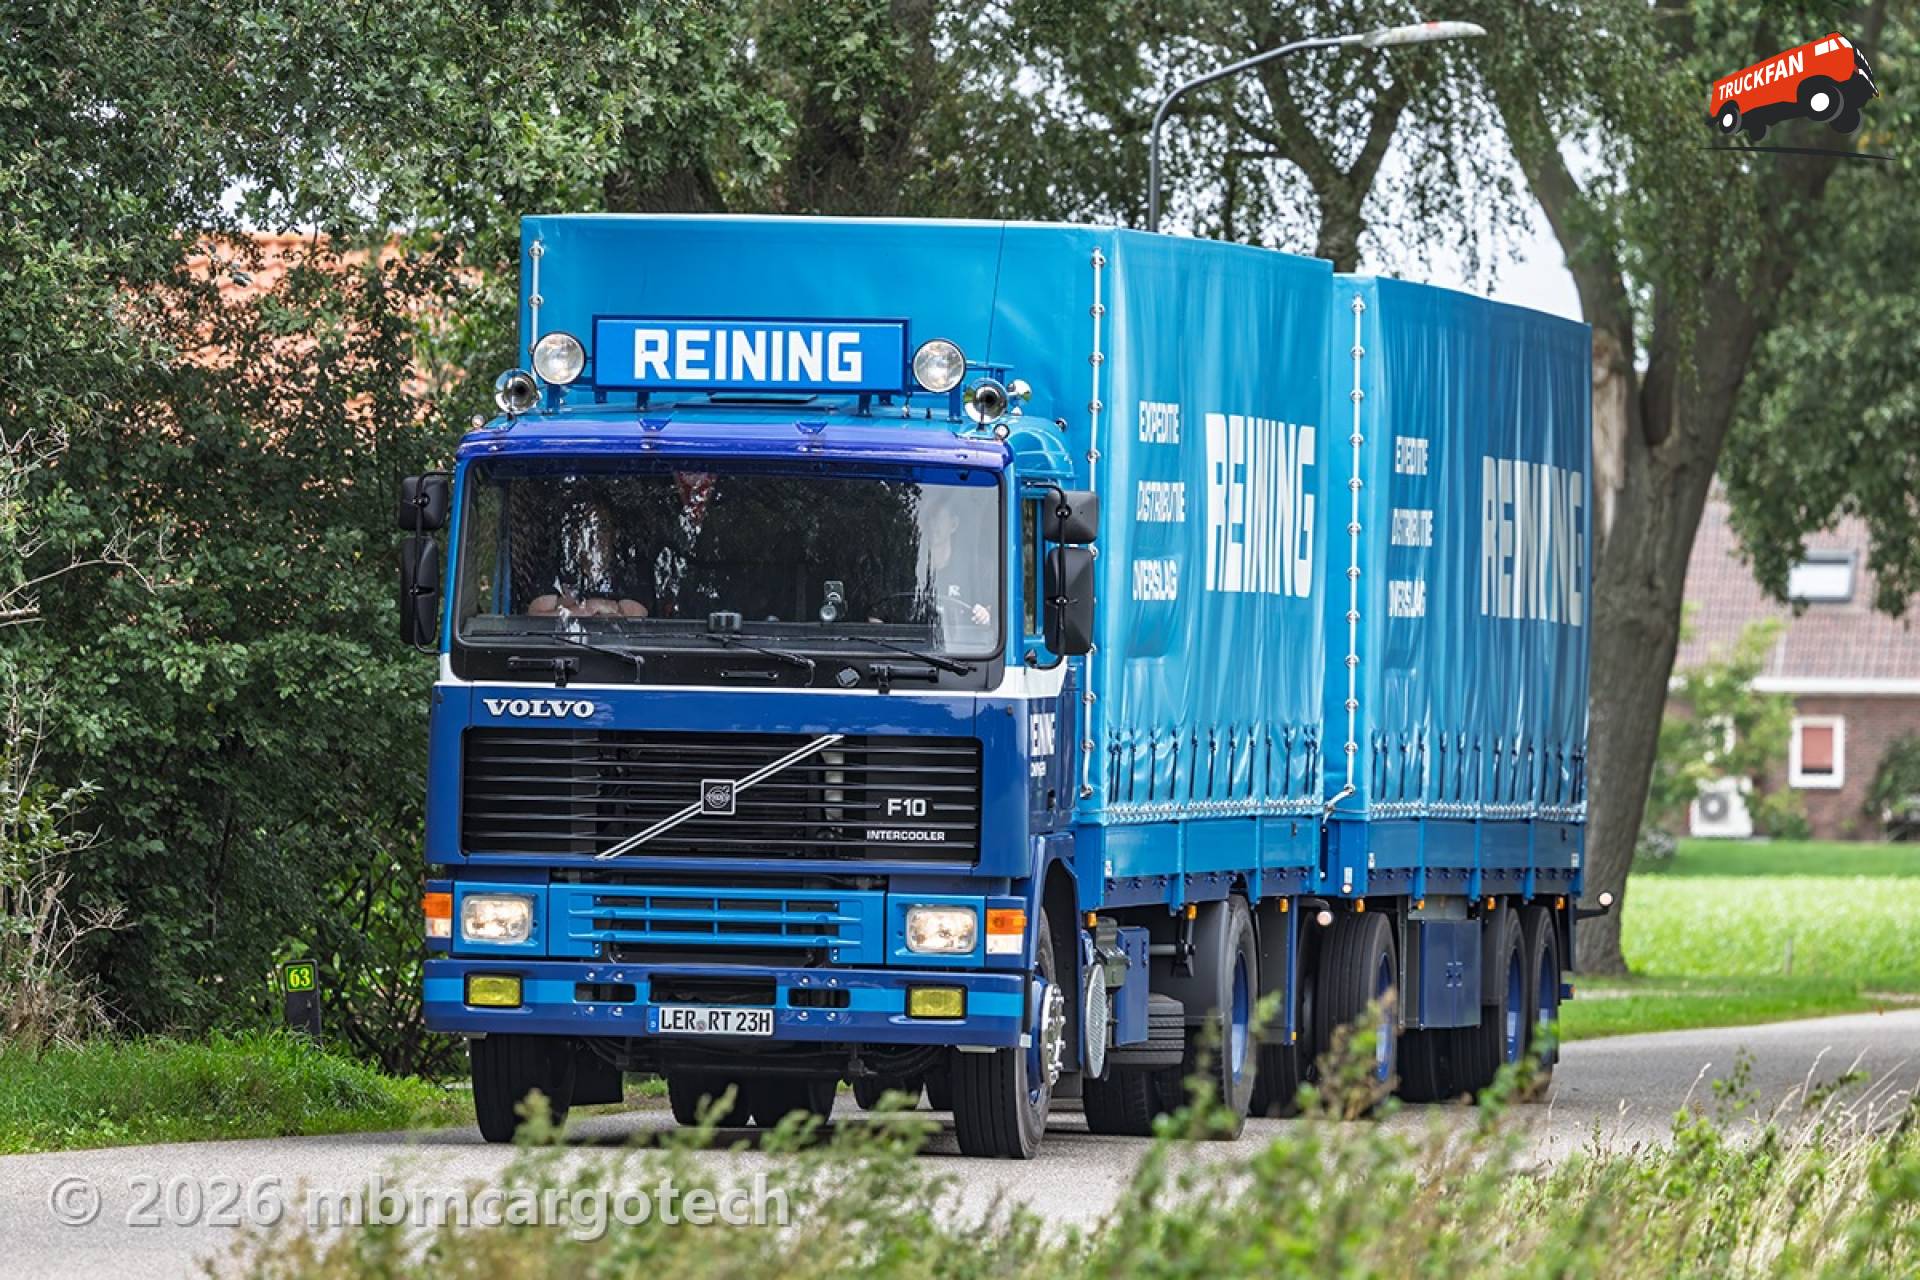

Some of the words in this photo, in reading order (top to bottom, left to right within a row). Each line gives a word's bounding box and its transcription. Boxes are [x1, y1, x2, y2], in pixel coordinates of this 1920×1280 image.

[634, 328, 862, 382] REINING
[1205, 412, 1315, 598] REINING
[1481, 455, 1583, 627] REINING
[482, 698, 595, 718] VOLVO
[887, 798, 926, 816] F10
[866, 830, 945, 841] INTERCOOLER
[289, 967, 311, 987] 63
[661, 1009, 696, 1030] LER
[708, 1011, 732, 1031] RT
[735, 1012, 770, 1032] 23H
